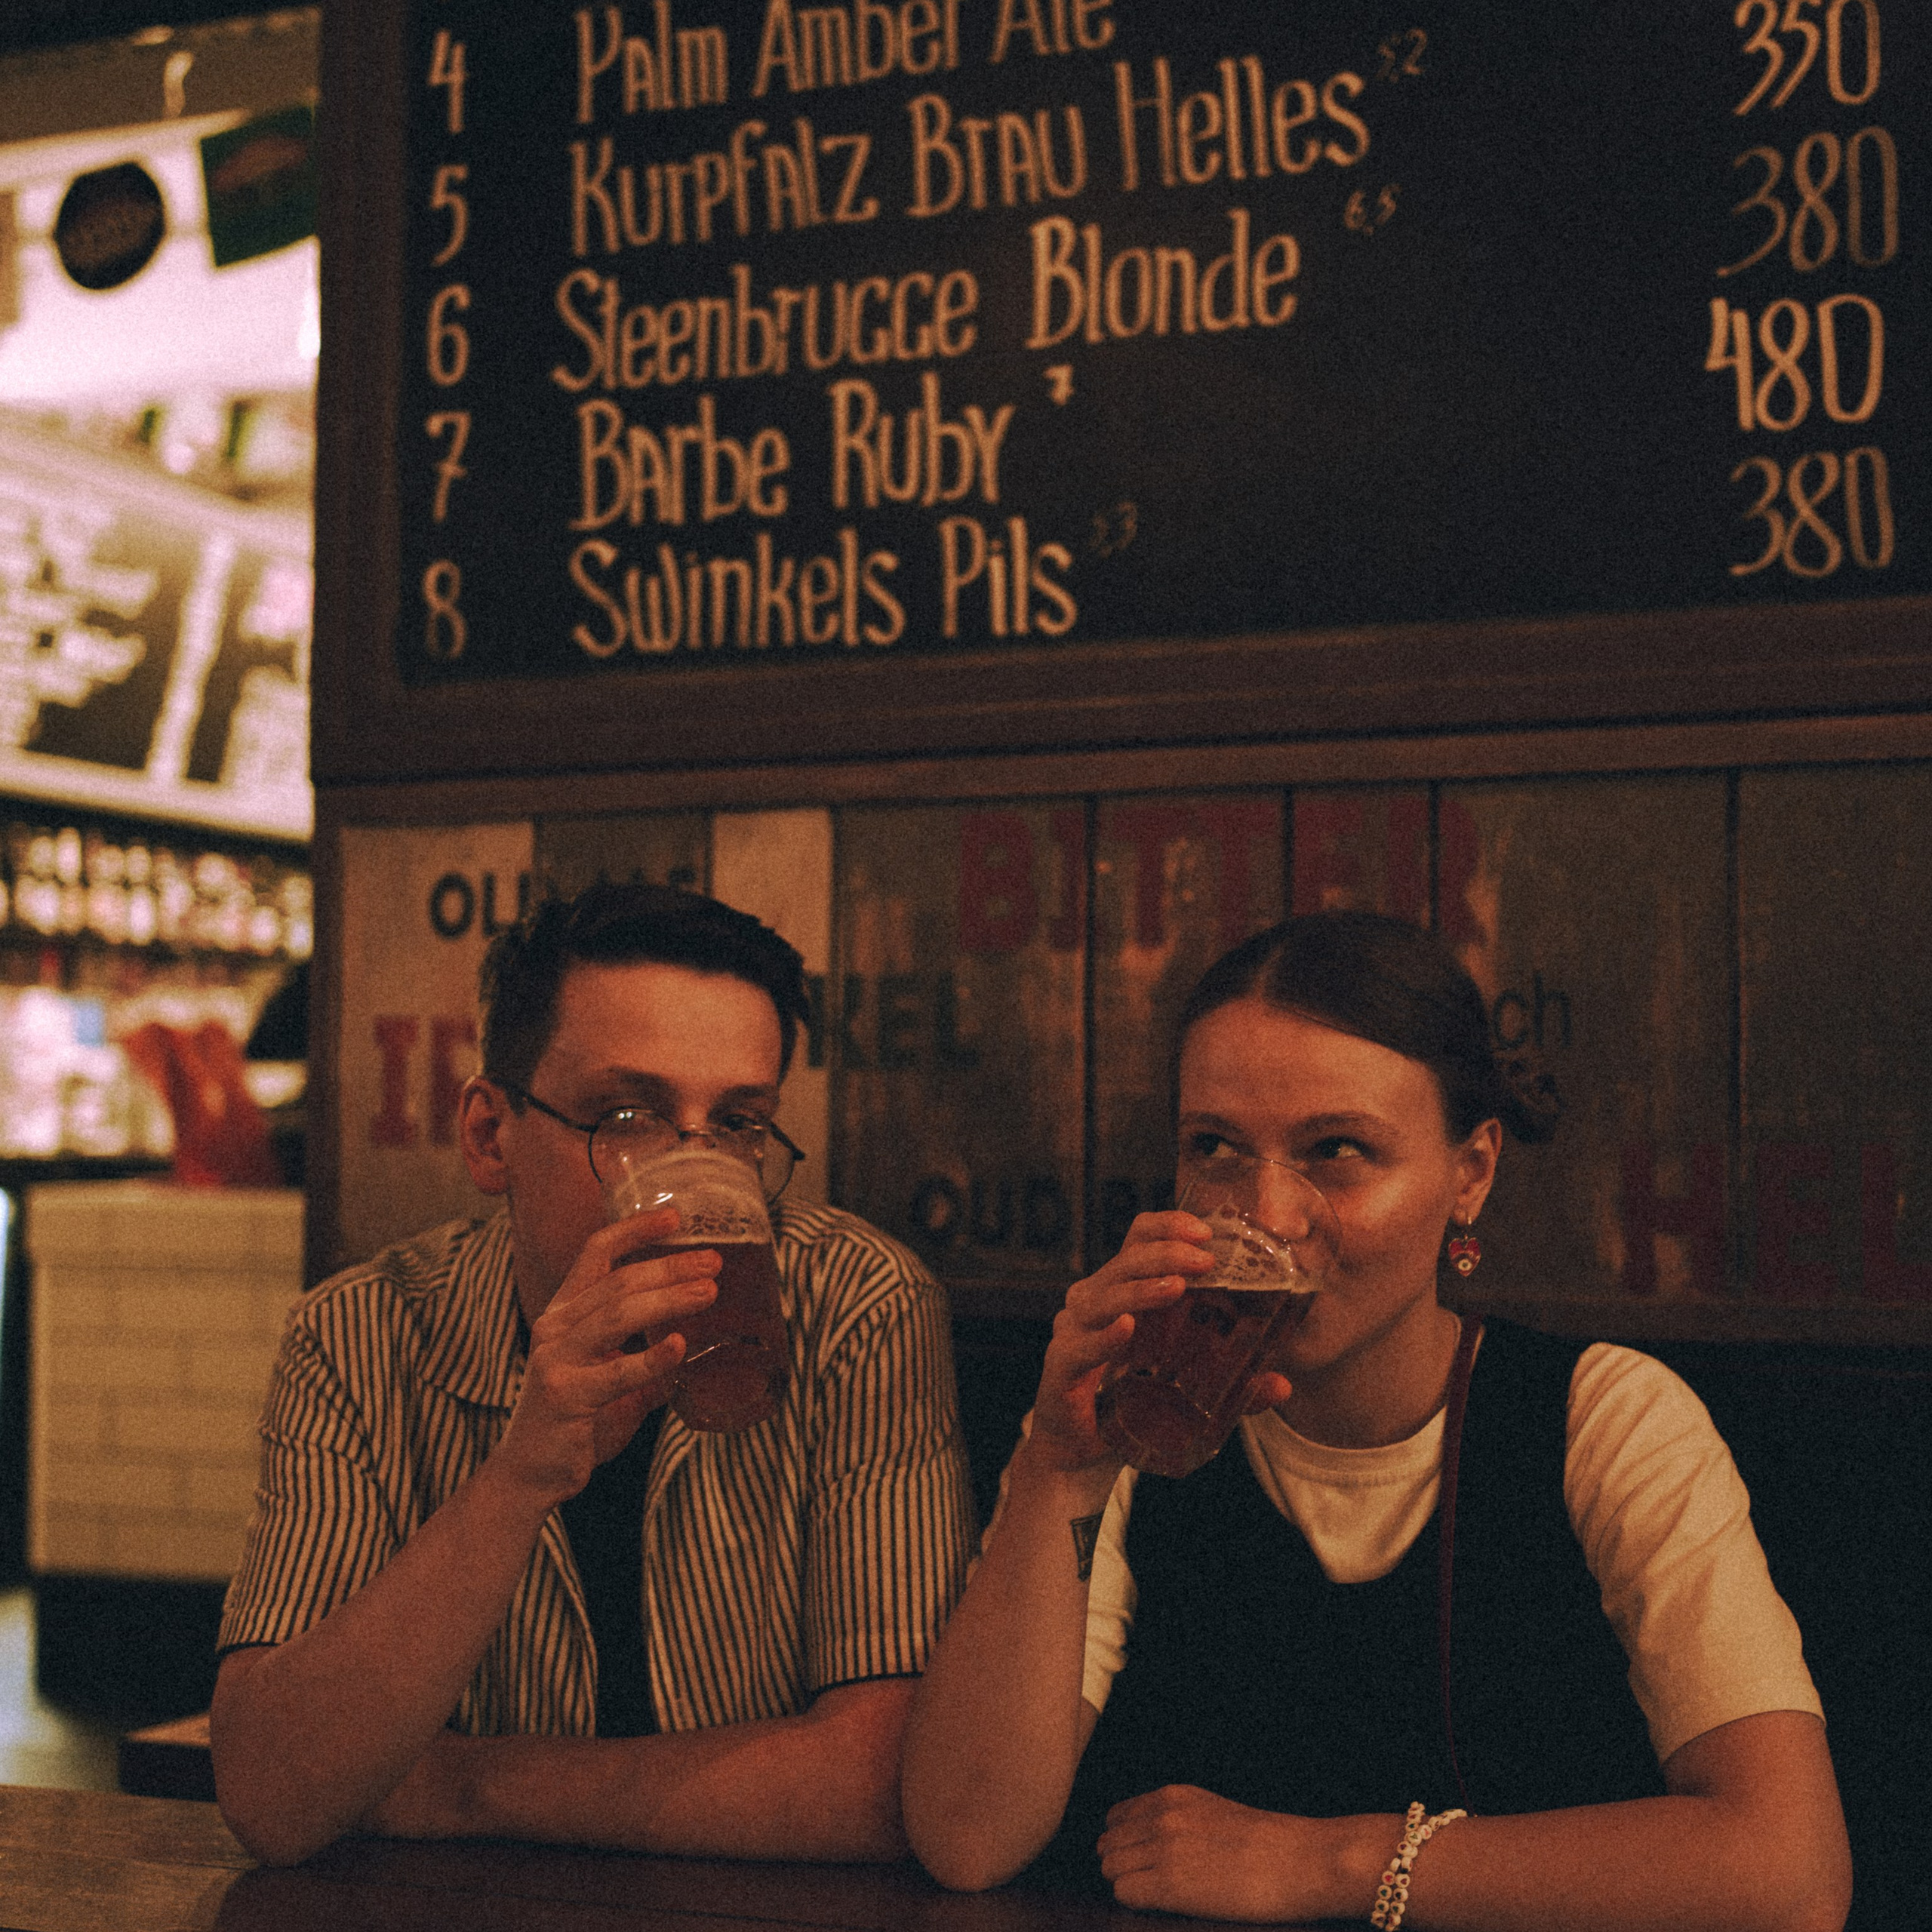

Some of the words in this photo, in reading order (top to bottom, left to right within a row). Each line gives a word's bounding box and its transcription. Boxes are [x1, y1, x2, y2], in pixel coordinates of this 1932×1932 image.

[428, 29, 466, 134] 4
[1113, 56, 1371, 192] Helles
[1733, 0, 1882, 115] 350
[429, 164, 469, 266] 5
[1715, 125, 1900, 278] 380
[426, 282, 471, 387] 6
[1026, 207, 1300, 349] Blonde
[1703, 292, 1885, 432] 480
[425, 410, 471, 522] 7
[1728, 445, 1896, 578] 380
[421, 558, 466, 657] 8
[570, 525, 906, 657] Swinkels
[939, 515, 1079, 638] Pils
[958, 798, 1482, 954] BITTER
